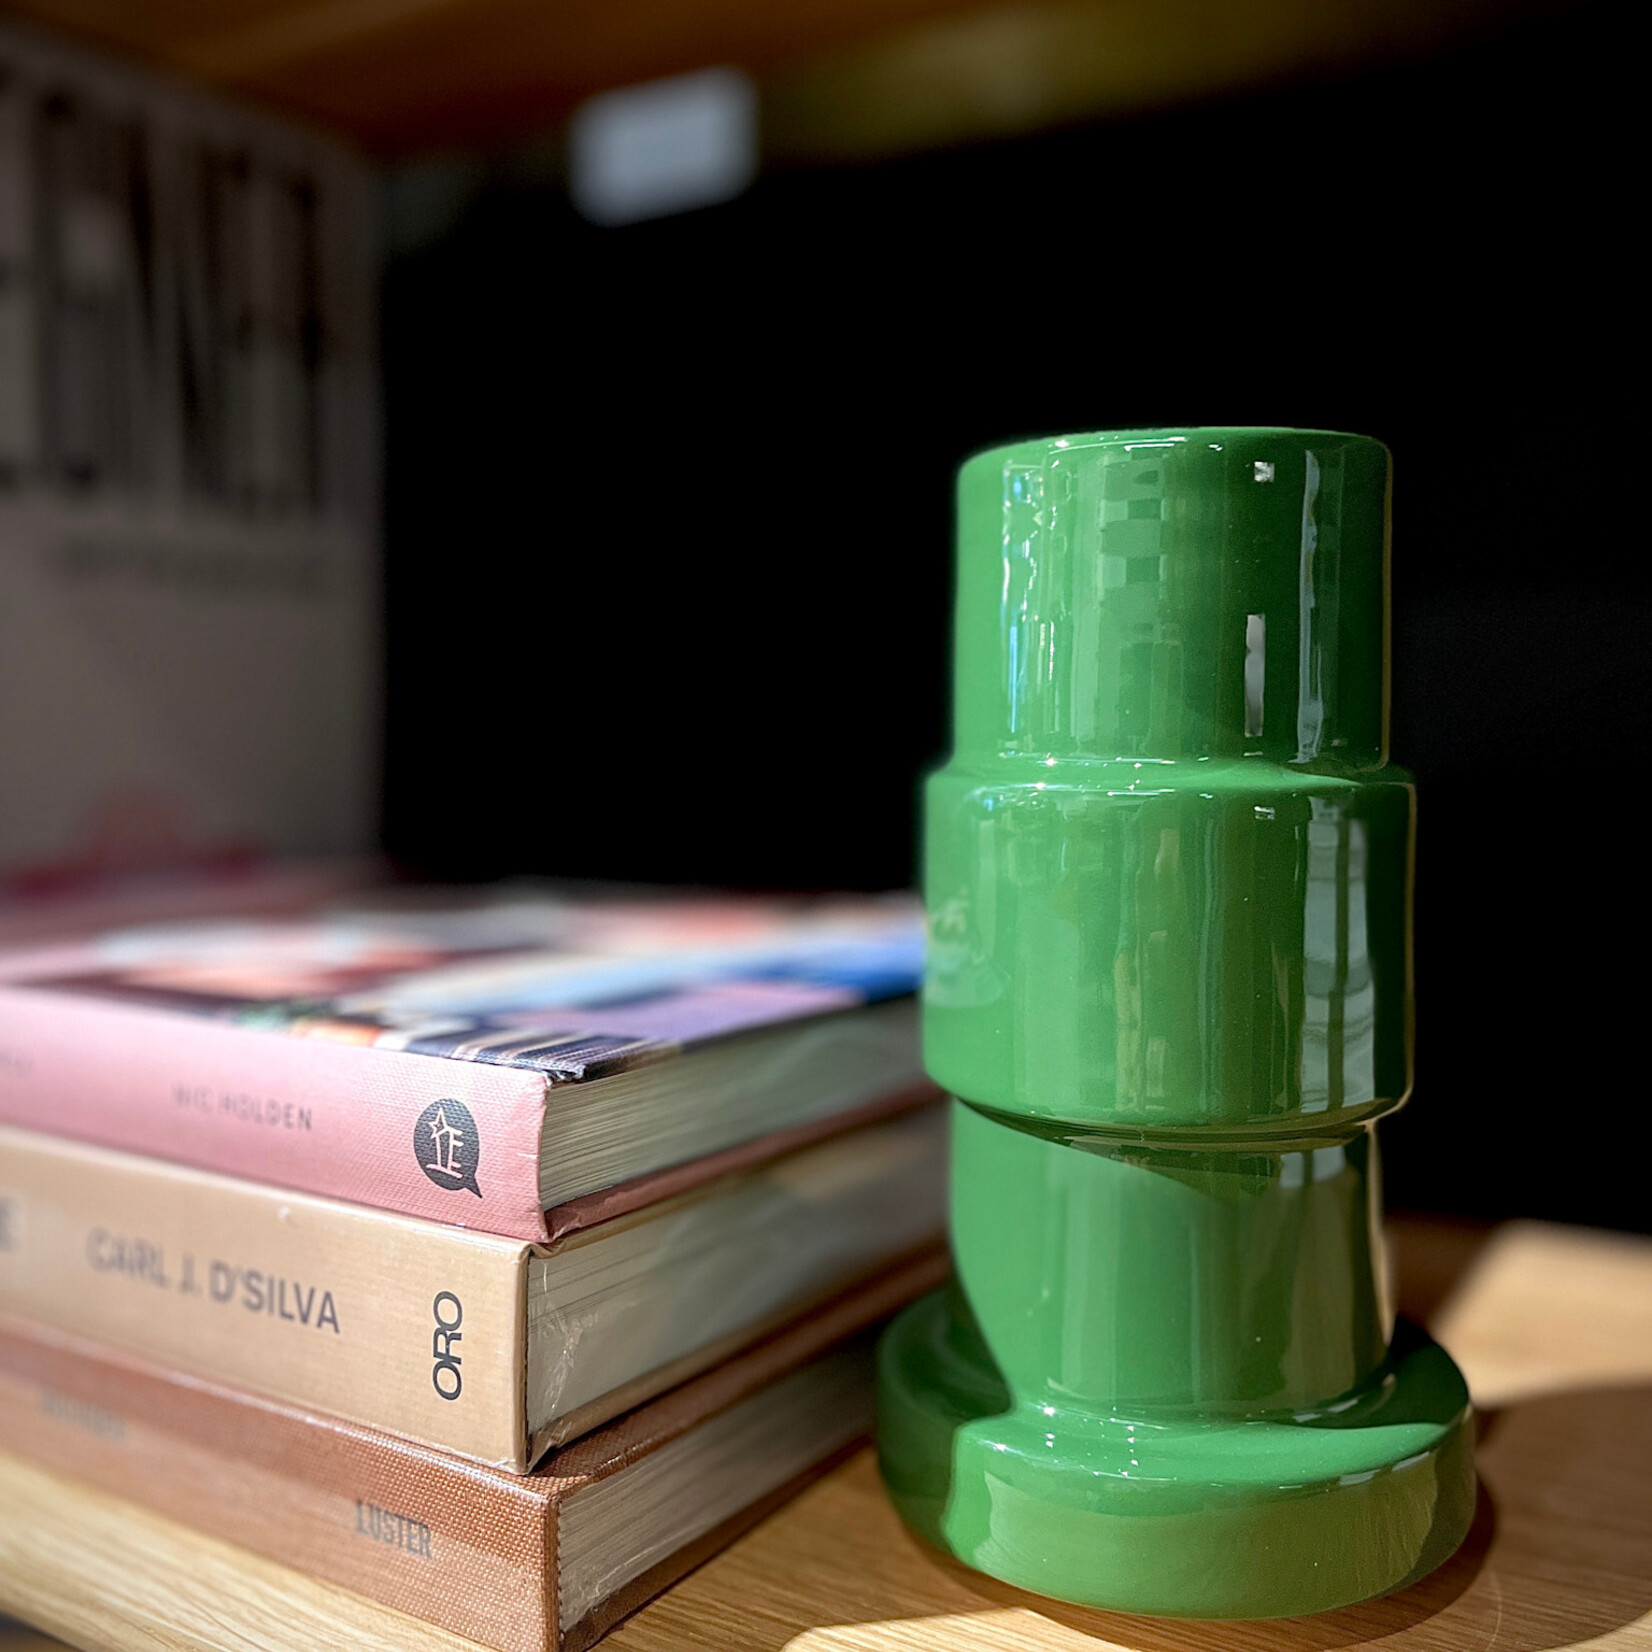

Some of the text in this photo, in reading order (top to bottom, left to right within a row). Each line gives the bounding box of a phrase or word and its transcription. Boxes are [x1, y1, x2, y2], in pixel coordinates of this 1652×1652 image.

[219, 1092, 313, 1131] HOLDEN
[87, 1227, 171, 1289] CARL
[210, 1260, 340, 1334] D'SILVA
[433, 1290, 462, 1400] ORO
[355, 1498, 432, 1560] LUSTER
